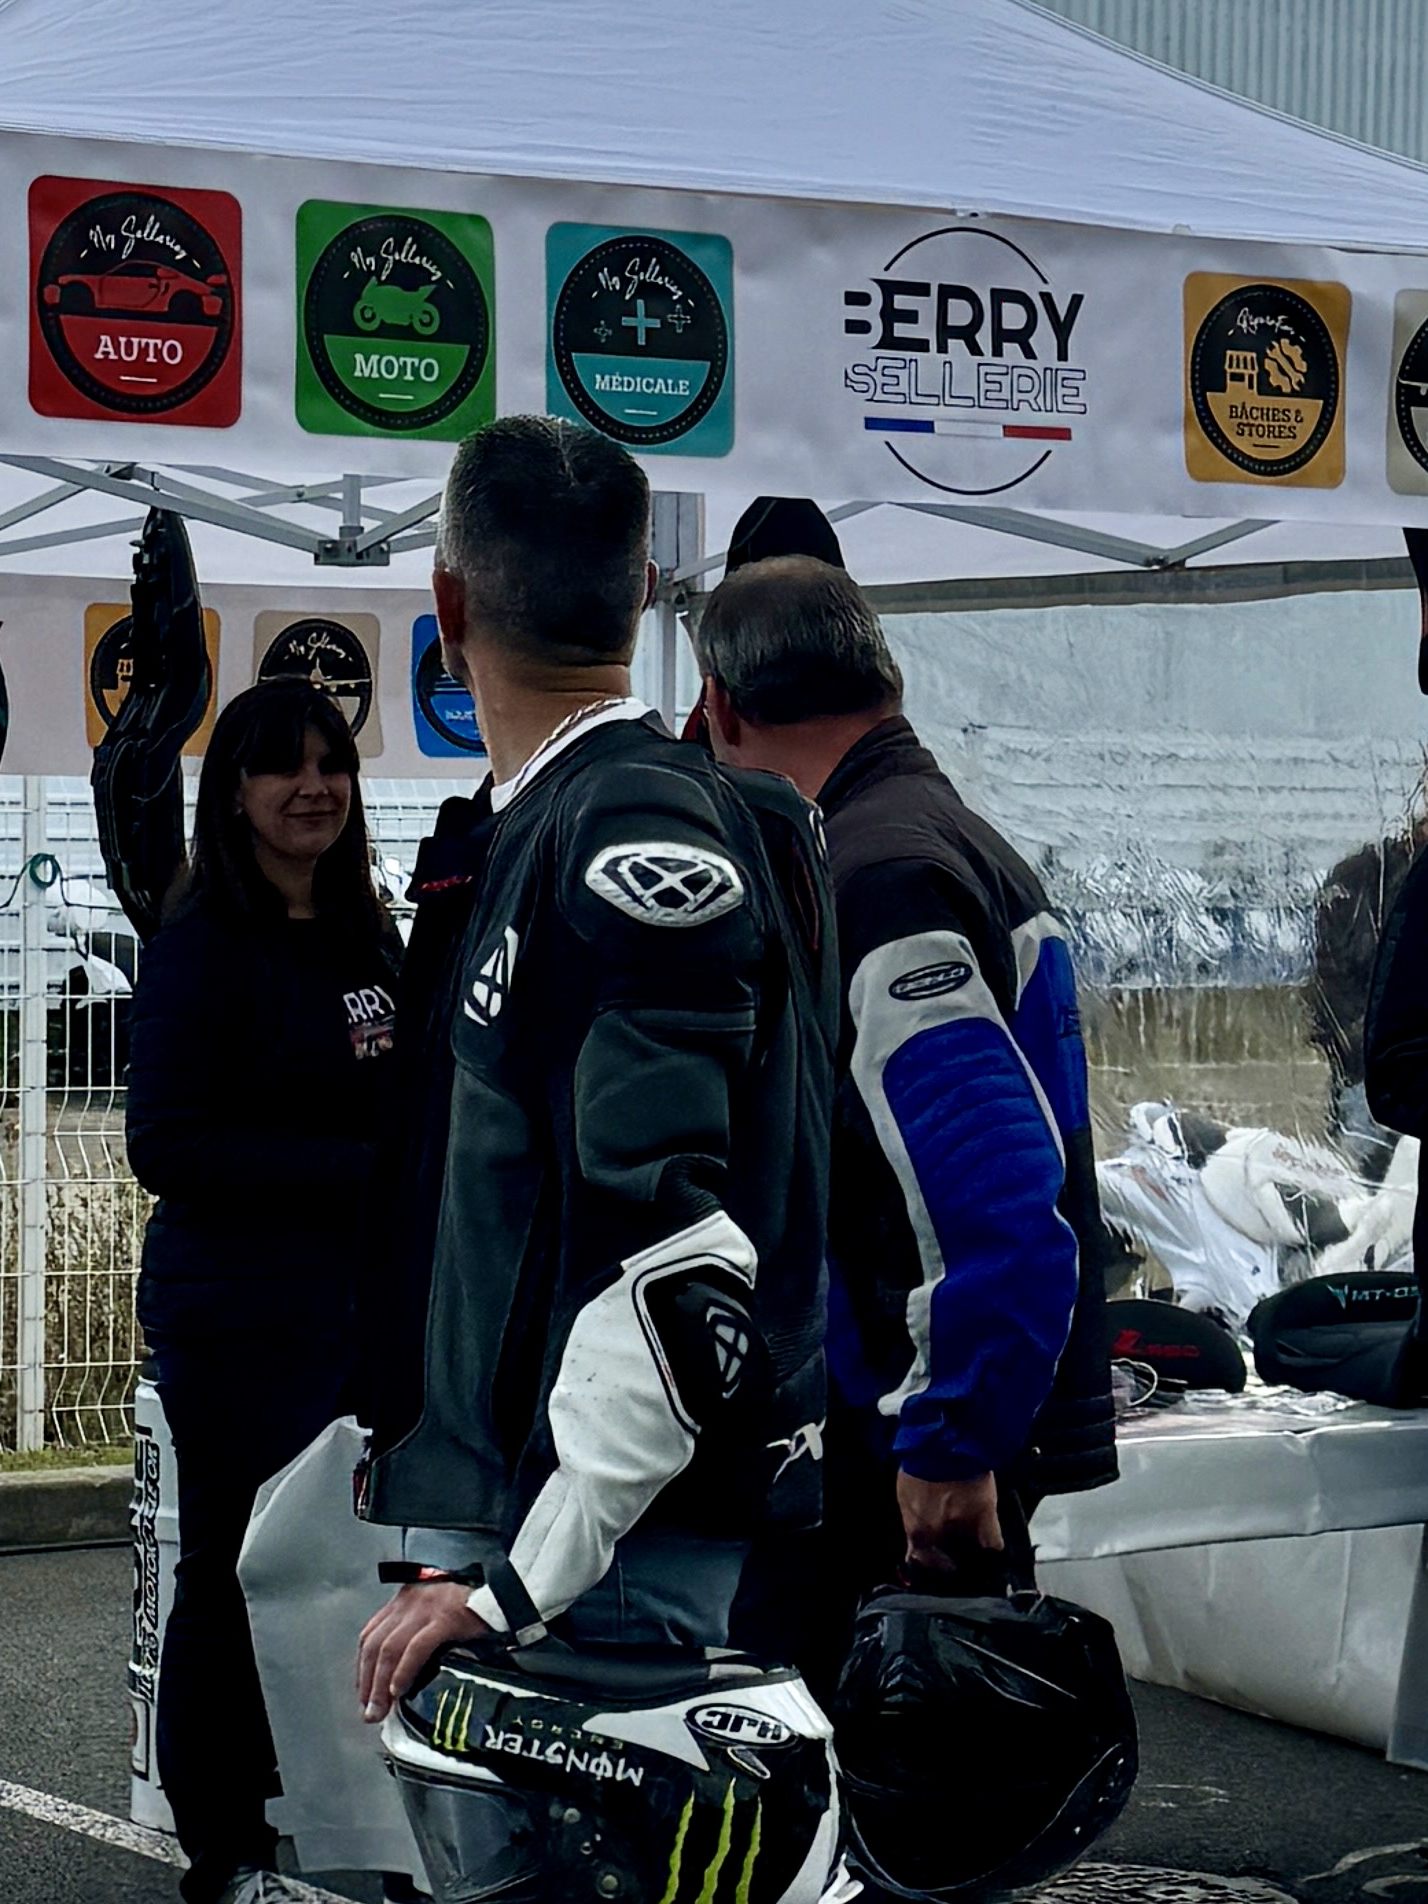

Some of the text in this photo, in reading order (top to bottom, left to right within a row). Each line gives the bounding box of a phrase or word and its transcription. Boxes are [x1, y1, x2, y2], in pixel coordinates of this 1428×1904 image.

[843, 277, 1085, 362] BERRY
[93, 335, 183, 365] AUTO
[353, 352, 439, 382] MOTO
[594, 372, 691, 396] MÉDICALE
[844, 355, 1088, 415] SELLERIE
[1228, 402, 1305, 424] BÂCHES &
[1235, 422, 1298, 440] STORES
[701, 1709, 782, 1741] HJC
[484, 1724, 645, 1787] MONSTER
